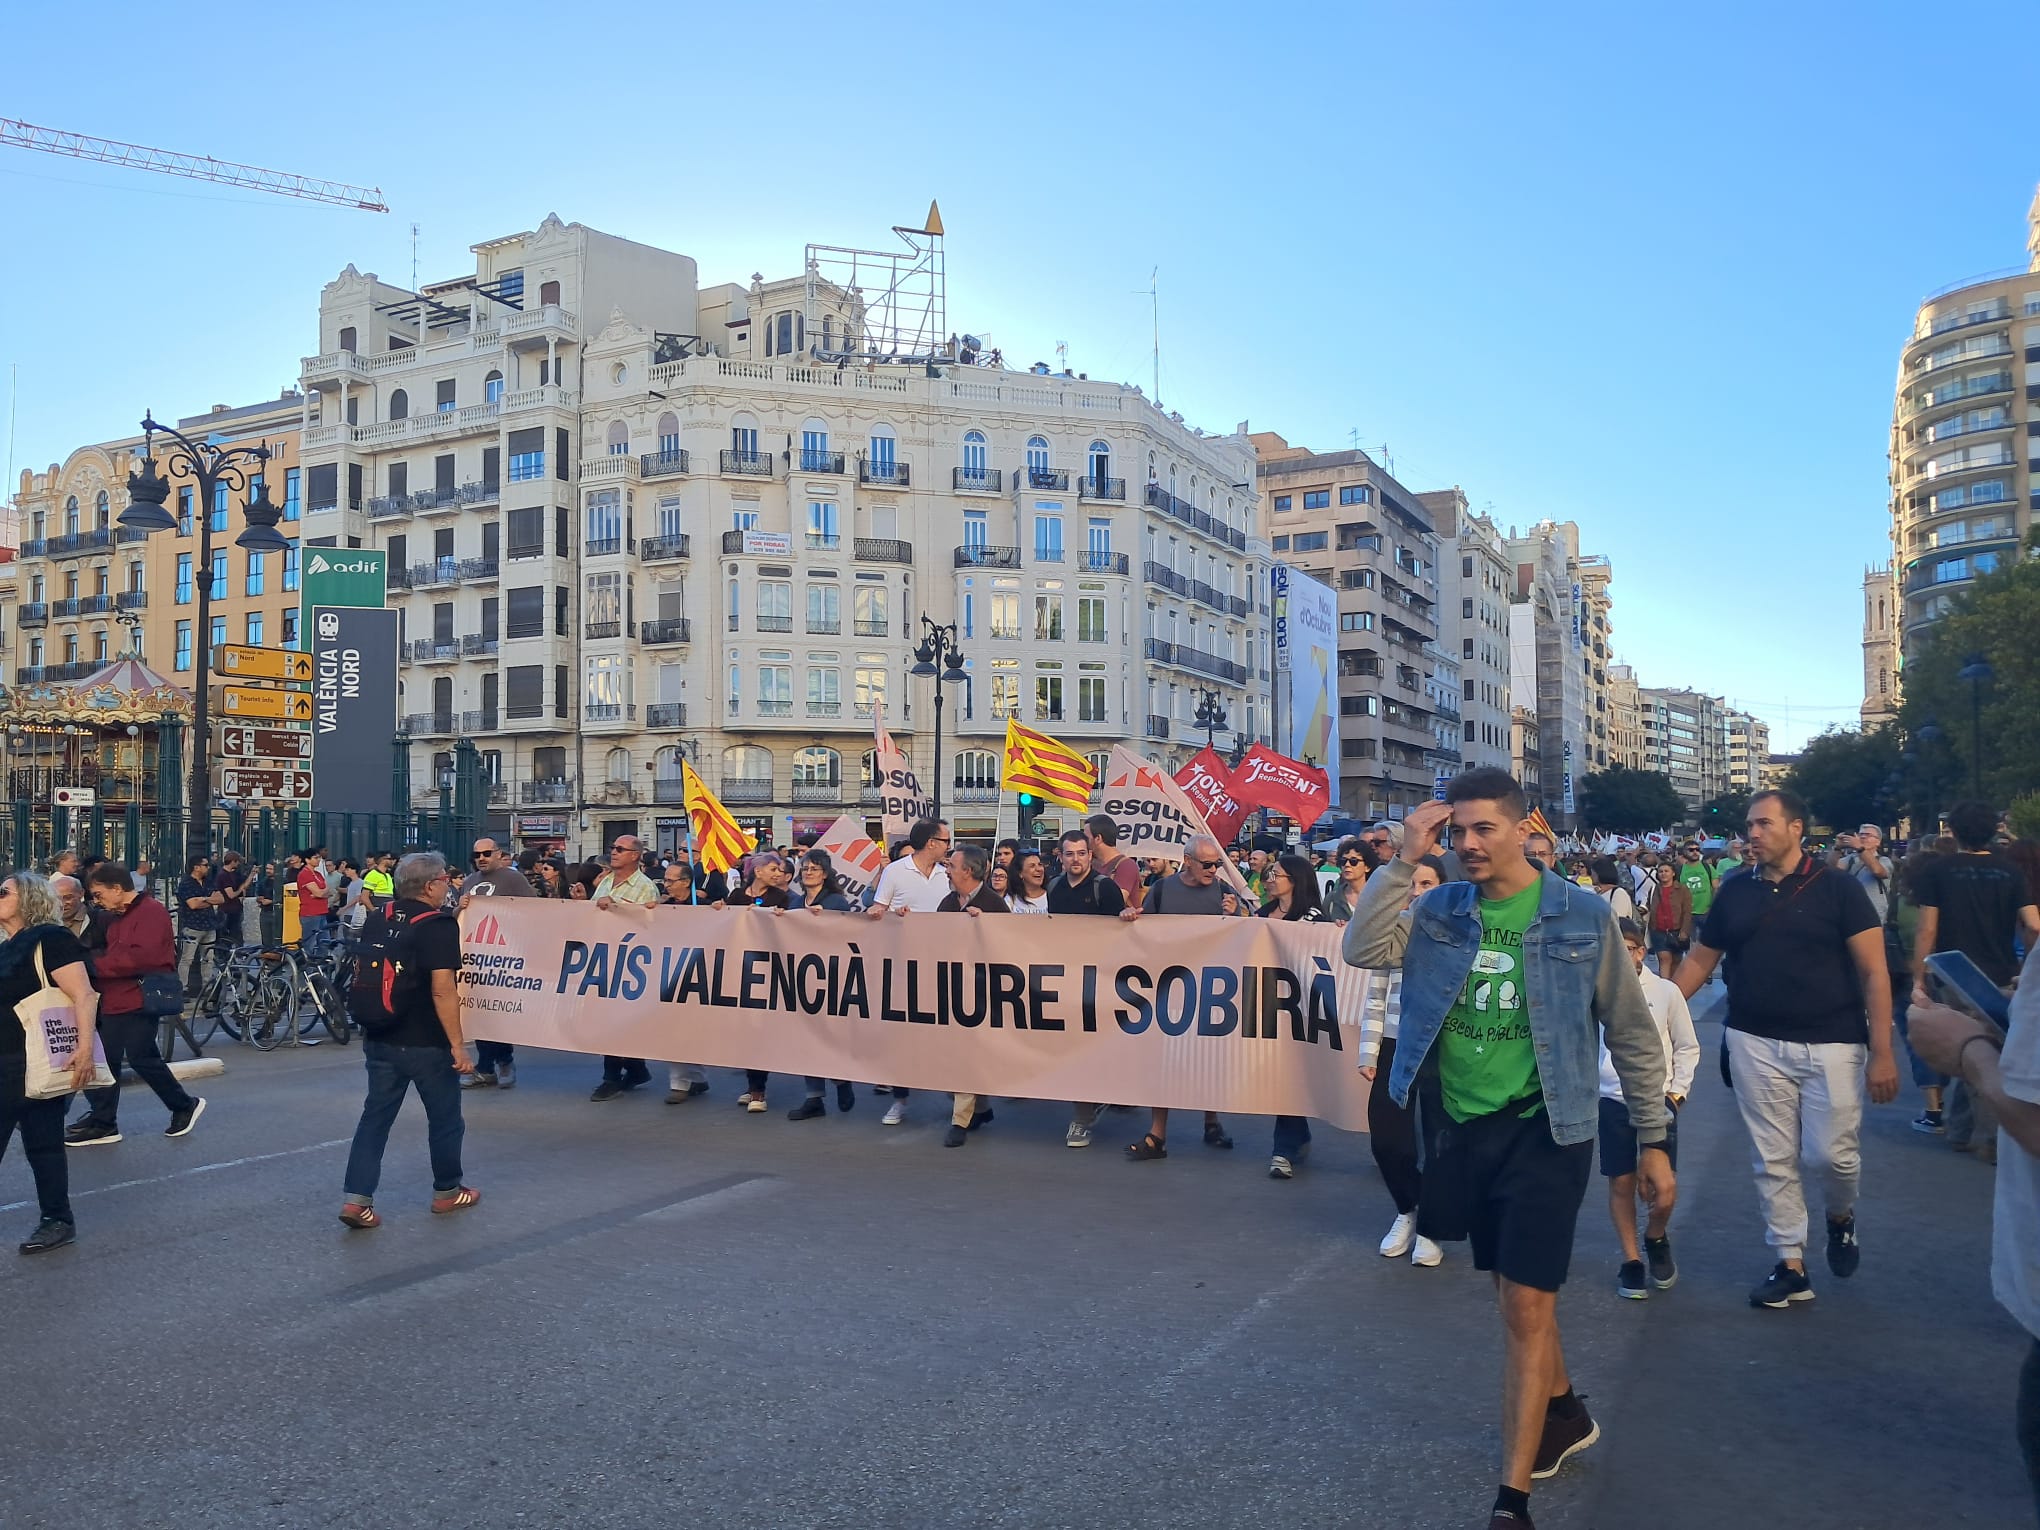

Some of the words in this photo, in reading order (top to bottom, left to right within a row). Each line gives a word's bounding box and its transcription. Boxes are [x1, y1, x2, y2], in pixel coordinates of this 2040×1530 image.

[241, 441, 287, 465] ZEIT
[333, 560, 381, 574] adif
[1318, 595, 1332, 616] Nou
[341, 649, 360, 698] NORD
[240, 695, 261, 703] Tourist
[315, 649, 338, 734] VALÈNCIA
[462, 952, 525, 971] esquerra
[458, 969, 543, 992] republicana
[555, 932, 652, 1001] PAÍS
[659, 942, 870, 1019] VALENCIÀ
[880, 957, 1066, 1032] LLIURE
[1082, 964, 1097, 1032] I
[1113, 955, 1343, 1052] SOBIRÀ
[476, 998, 523, 1014] VALENCIÀ
[45, 1018, 62, 1028] the
[46, 1025, 79, 1037] Nottin
